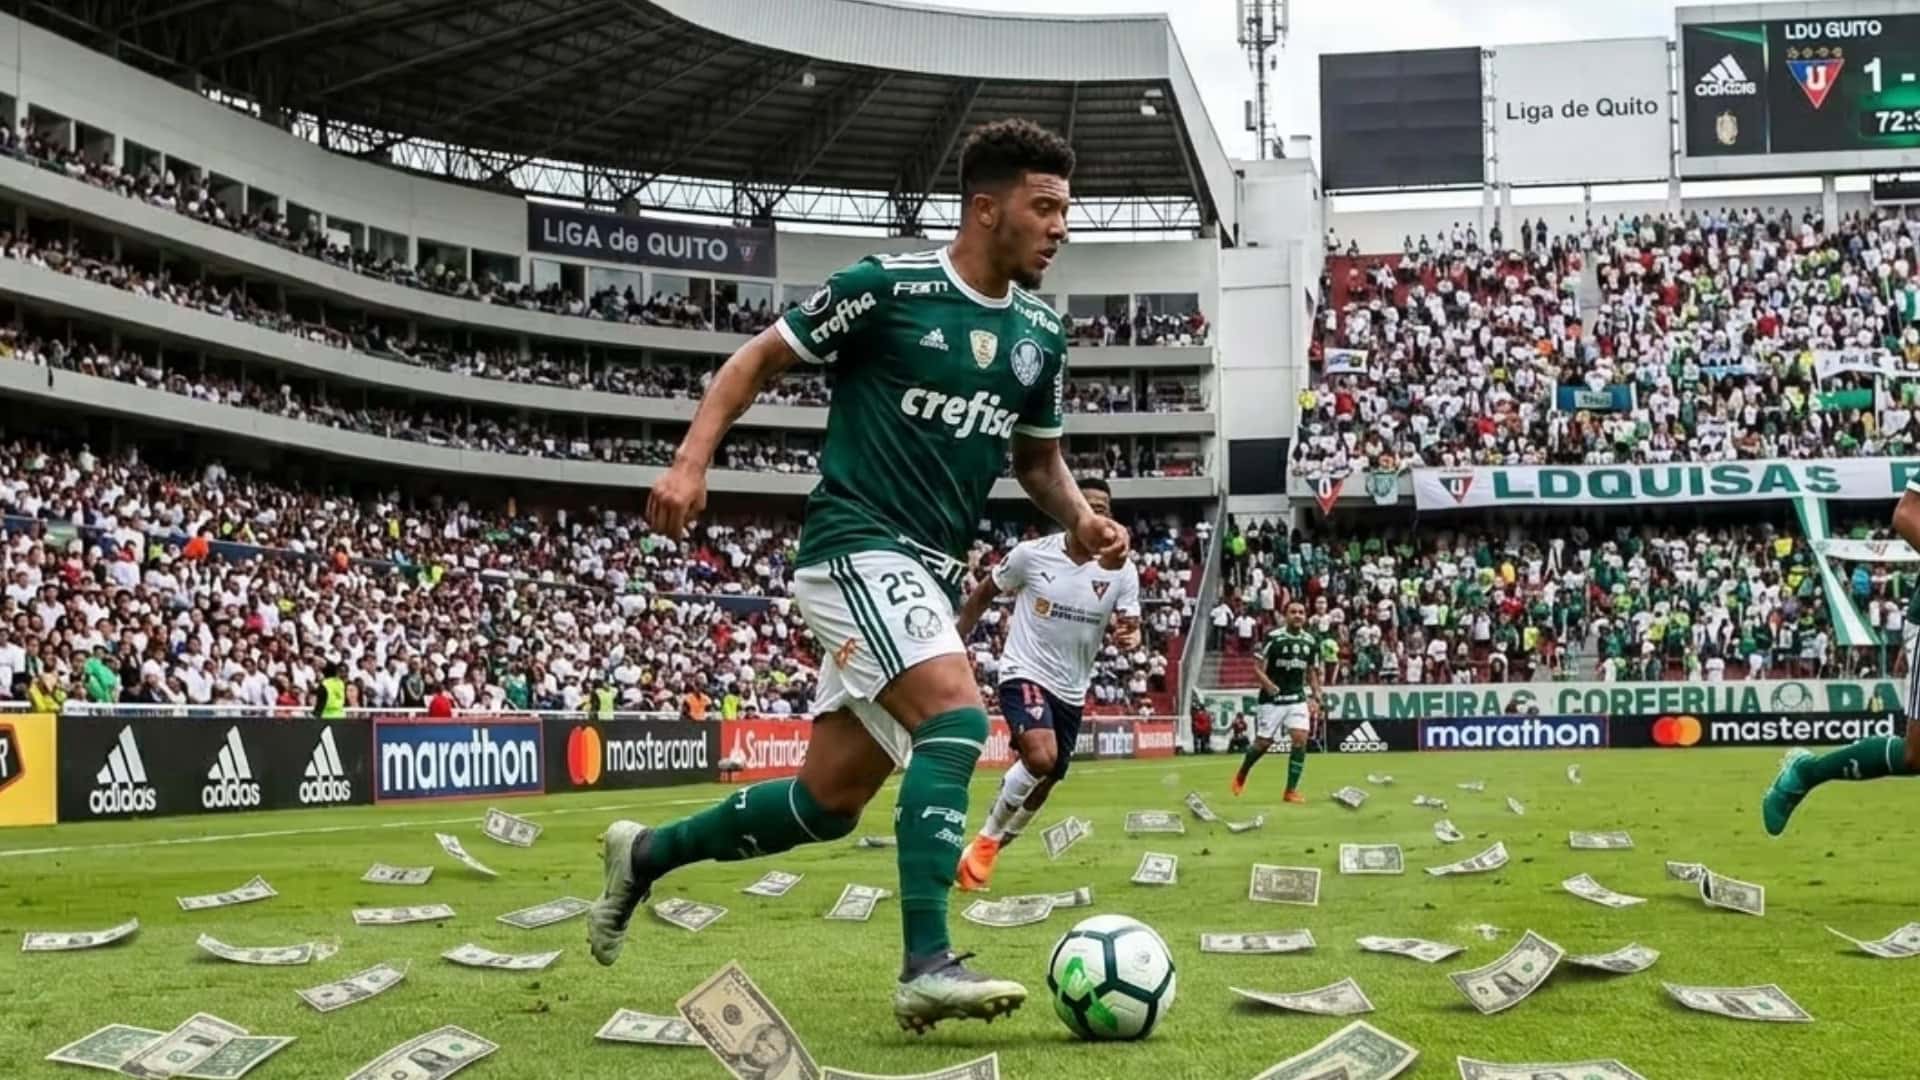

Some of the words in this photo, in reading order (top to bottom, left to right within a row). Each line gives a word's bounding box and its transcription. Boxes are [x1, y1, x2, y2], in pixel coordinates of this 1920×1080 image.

[1785, 23, 1821, 39] LDU
[1863, 56, 1882, 93] 1
[1506, 101, 1554, 125] Liga
[1561, 99, 1590, 118] de
[1596, 97, 1659, 117] Quito
[543, 217, 602, 249] LIGA
[609, 227, 639, 252] de
[647, 232, 728, 262] QUITO
[880, 570, 926, 606] 25
[1426, 719, 1599, 748] marathon
[1711, 713, 1894, 741] mastercard
[382, 729, 539, 791] marathon
[606, 730, 708, 771] mastercard
[745, 729, 809, 769] Santande
[89, 782, 156, 815] adidas
[202, 779, 261, 809] adidas
